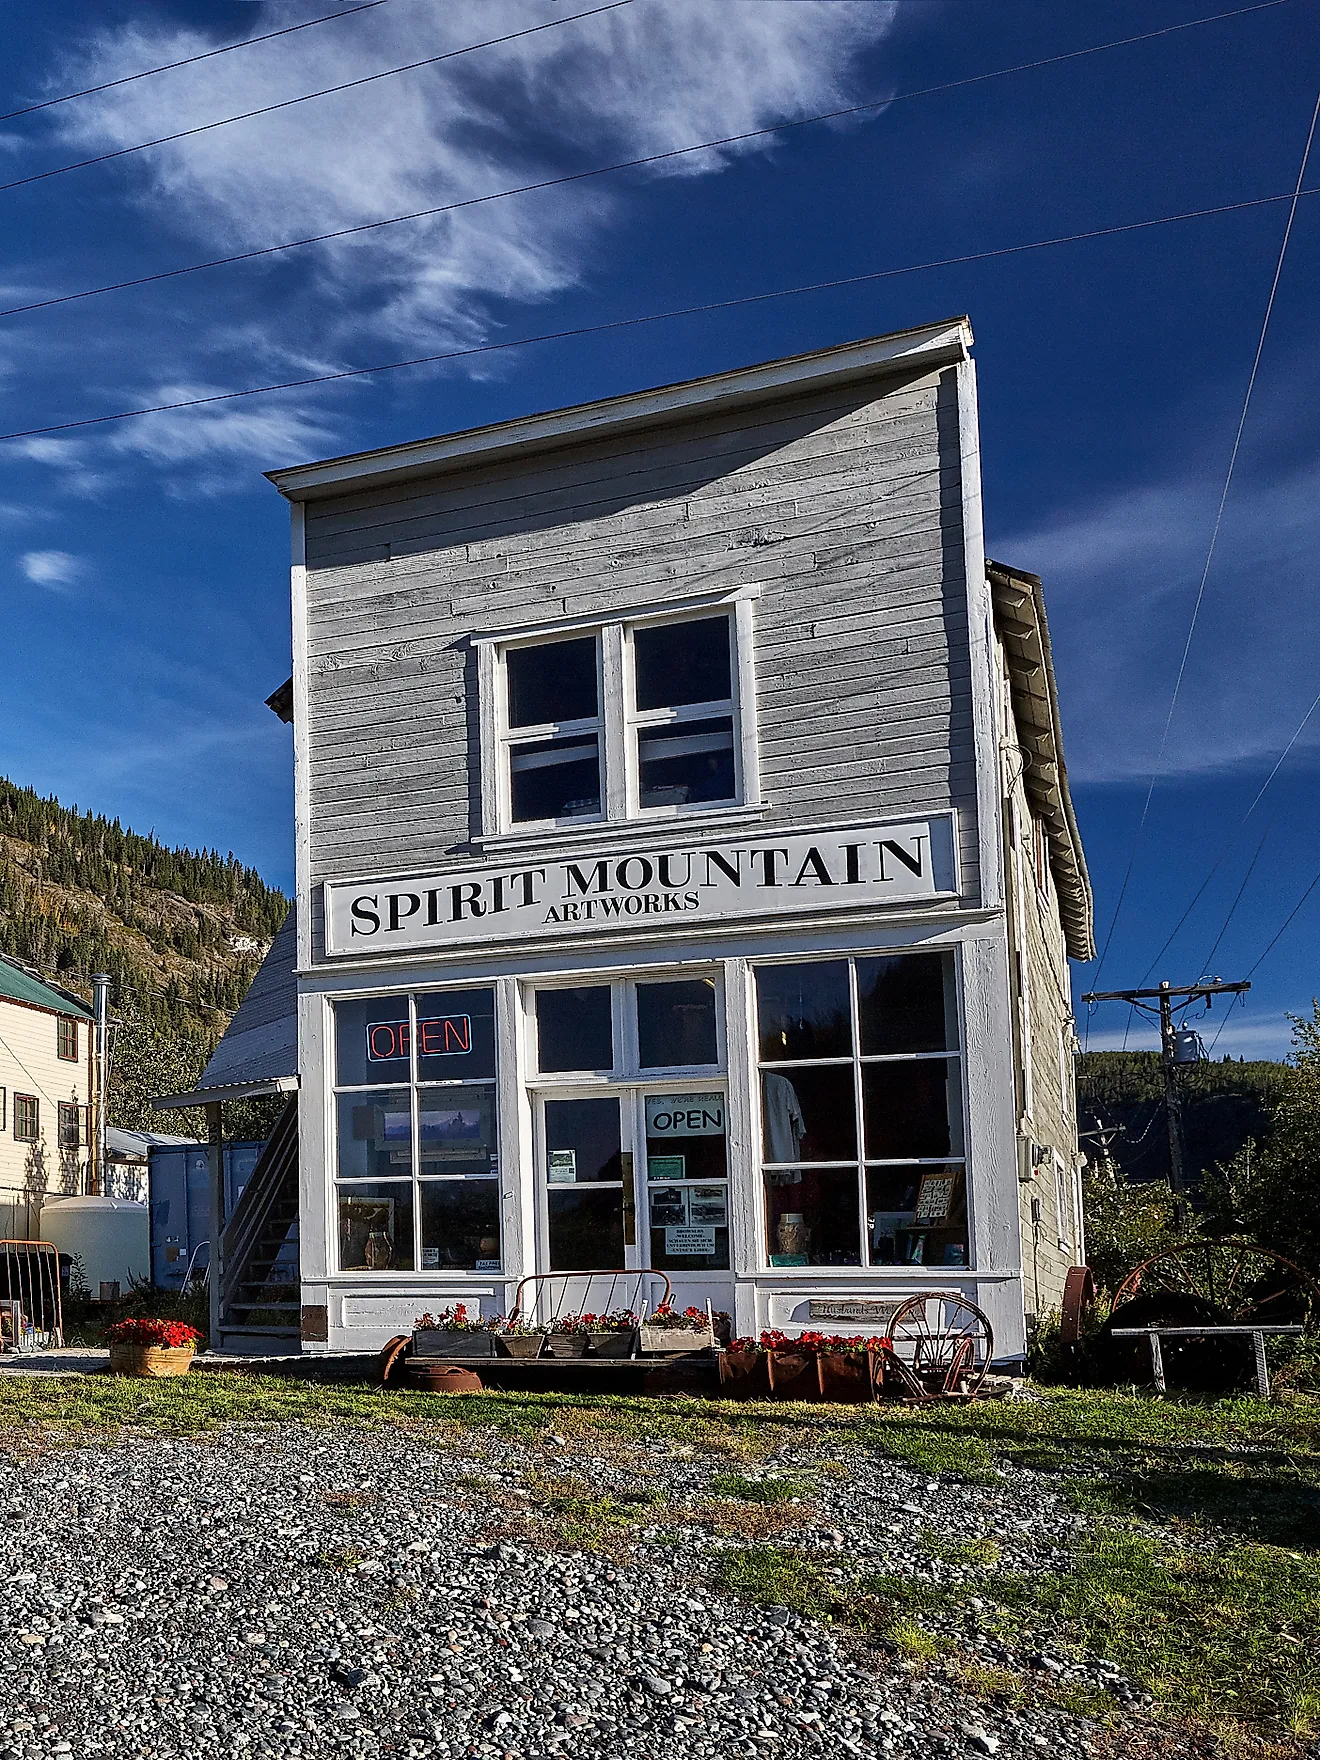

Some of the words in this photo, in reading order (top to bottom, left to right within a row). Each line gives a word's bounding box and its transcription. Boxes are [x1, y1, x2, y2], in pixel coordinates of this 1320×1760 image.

[350, 868, 546, 938] SPIRIT
[560, 834, 929, 899] MOUNTAIN
[541, 890, 700, 924] ARTWORKS
[371, 1017, 469, 1057] OPEN
[653, 1109, 722, 1131] OPEN
